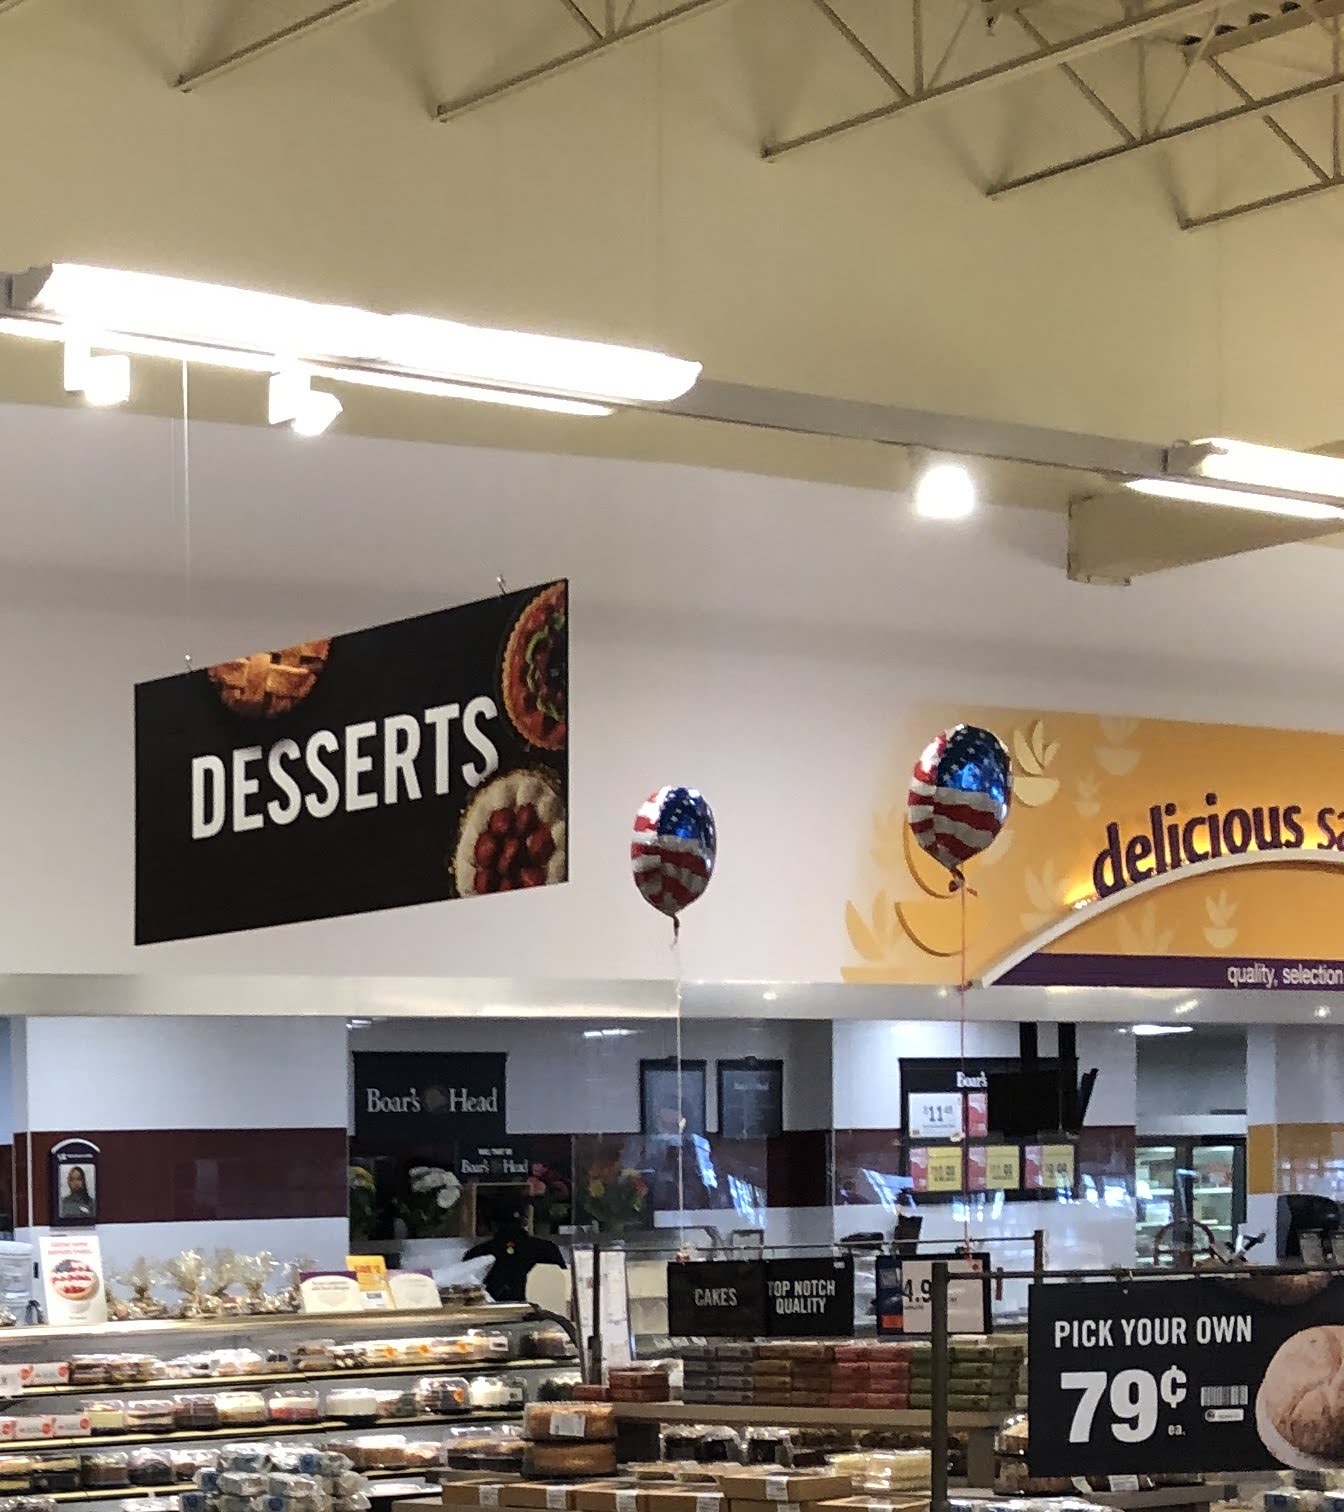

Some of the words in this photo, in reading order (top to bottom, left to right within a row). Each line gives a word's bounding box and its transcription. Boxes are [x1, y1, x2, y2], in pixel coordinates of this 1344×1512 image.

[191, 695, 500, 840] DESSERTS
[1092, 792, 1305, 899] delicious
[1227, 962, 1278, 988] quality,
[1282, 963, 1344, 985] selection
[366, 1087, 421, 1113] Boar's
[448, 1087, 499, 1113] Head
[694, 1287, 738, 1308] CAKES
[767, 1280, 791, 1298] TOP
[793, 1279, 836, 1297] NOTCH
[775, 1297, 827, 1315] QUALITY
[1054, 1319, 1114, 1348] PICK
[1120, 1317, 1188, 1346] YOUR
[1196, 1314, 1253, 1344] OWN
[1060, 1364, 1188, 1443] 79¢
